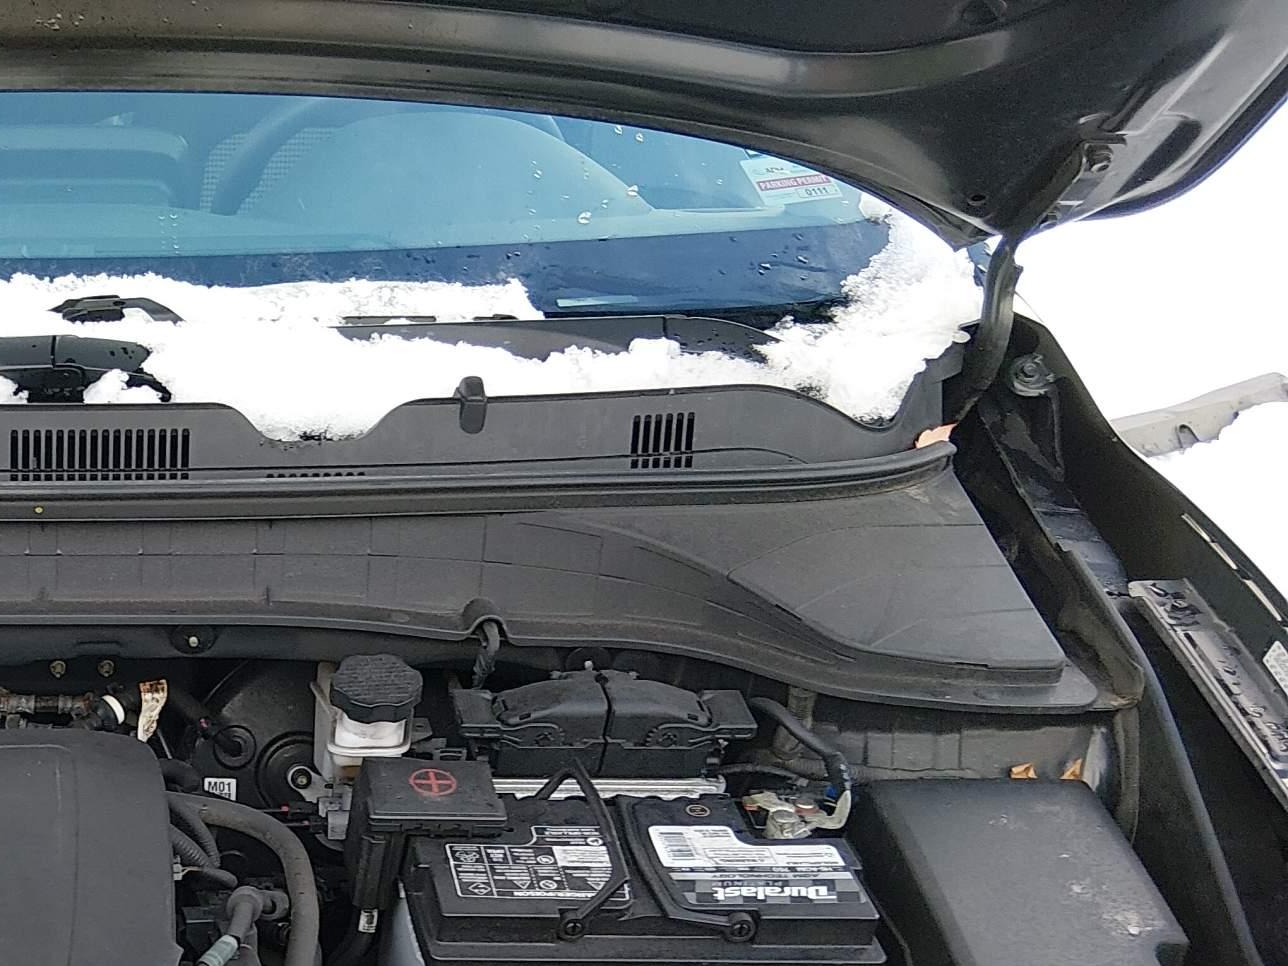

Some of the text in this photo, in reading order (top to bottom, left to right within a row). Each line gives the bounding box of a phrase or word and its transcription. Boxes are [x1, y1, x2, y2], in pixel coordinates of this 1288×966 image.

[759, 179, 798, 190] PARKING
[208, 781, 231, 792] M01
[712, 886, 837, 900] Duralast
